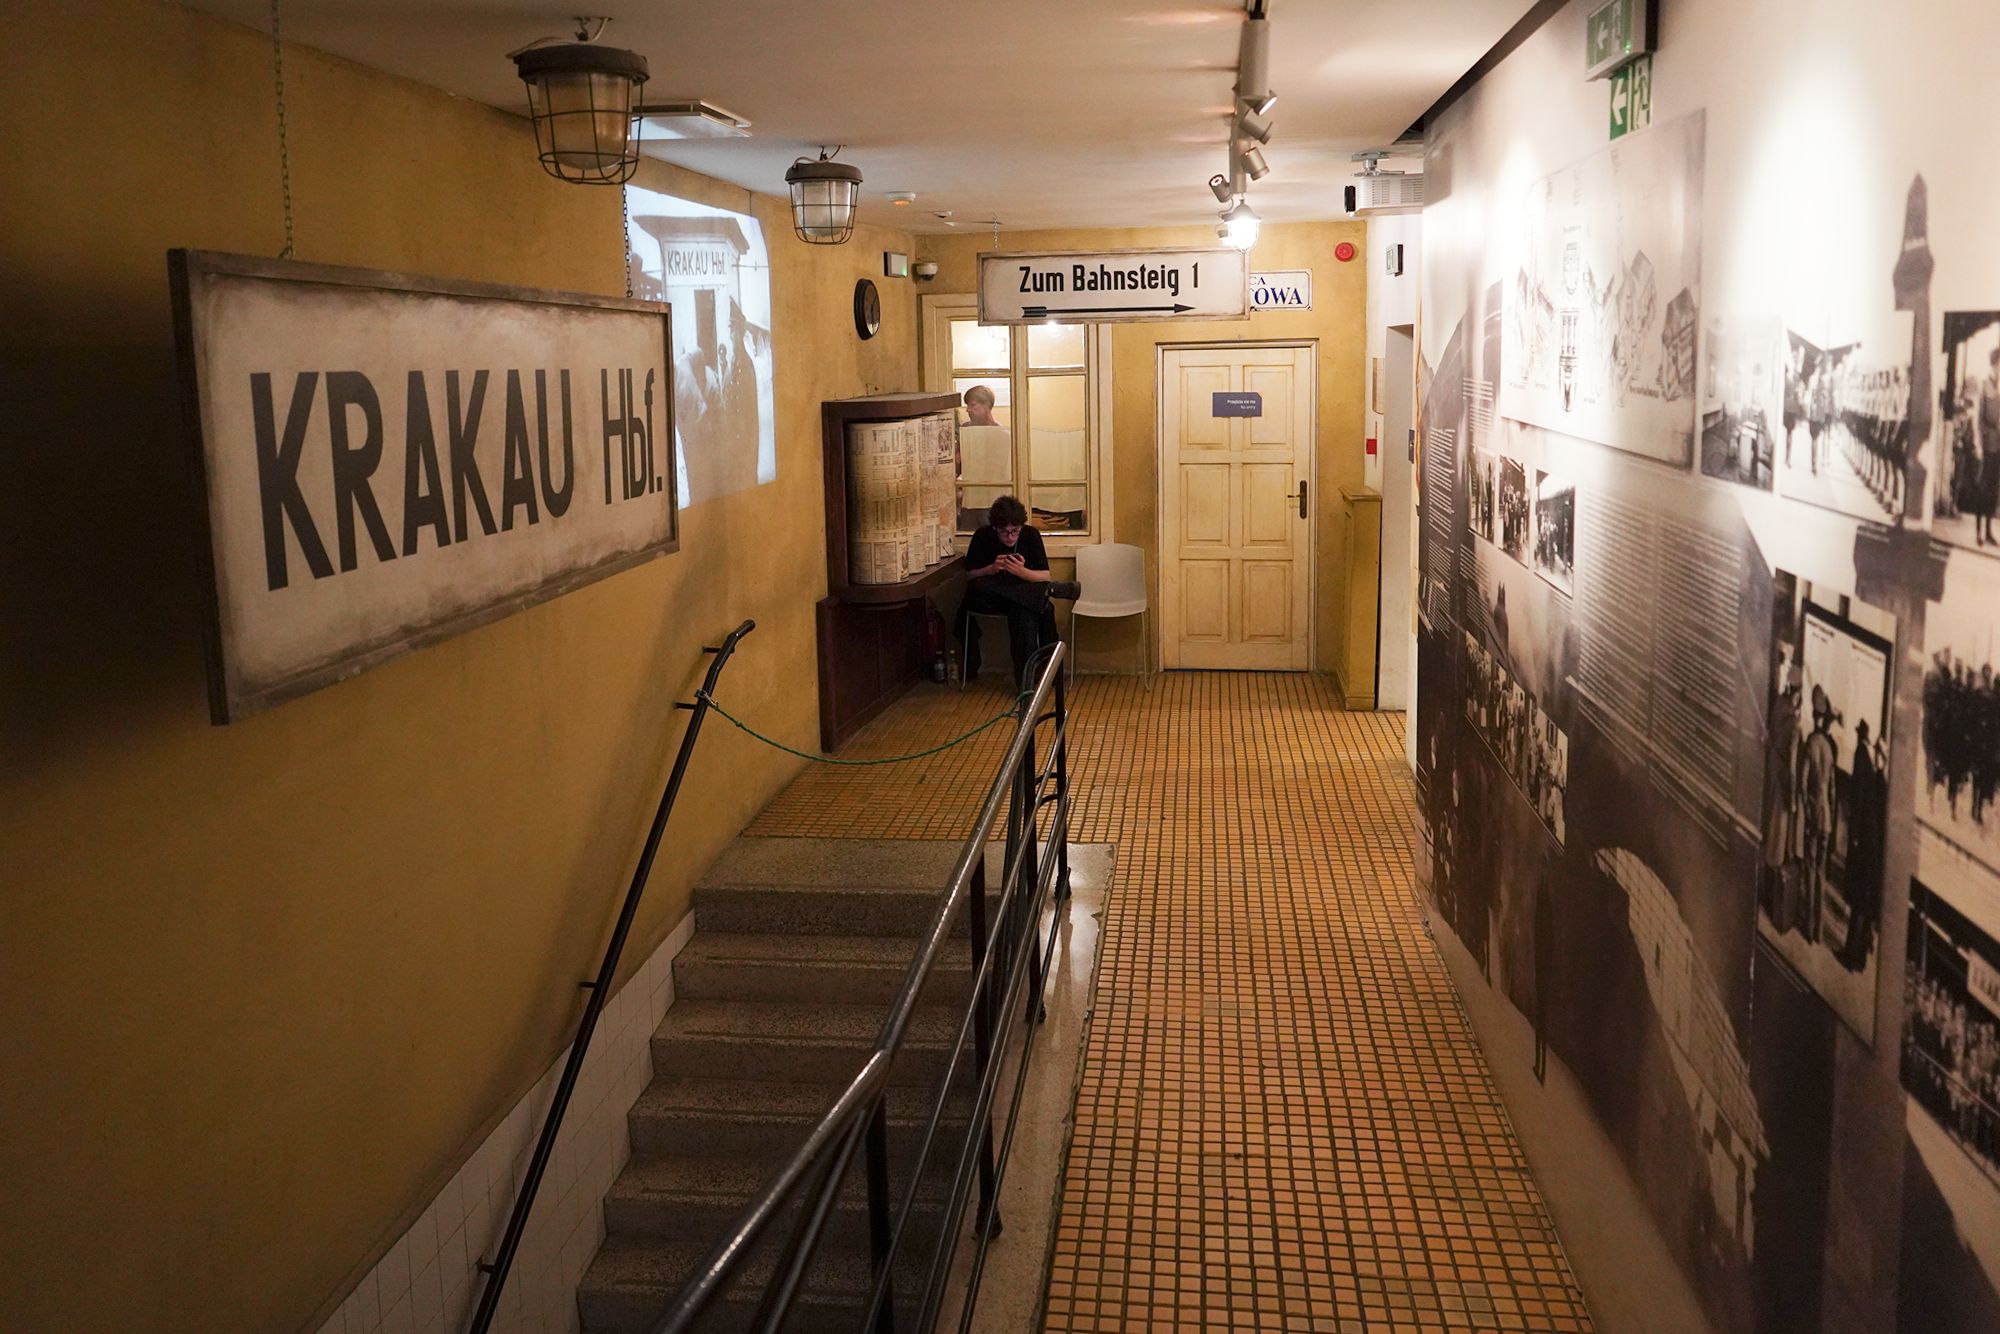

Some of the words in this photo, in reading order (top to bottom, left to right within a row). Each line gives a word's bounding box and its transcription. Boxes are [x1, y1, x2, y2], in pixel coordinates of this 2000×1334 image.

[667, 250, 708, 276] KRAKAU
[1019, 266, 1064, 293] Zum
[1072, 263, 1179, 297] Bahnsteig
[1191, 262, 1199, 289] 1
[1250, 287, 1303, 306] OWA
[250, 368, 575, 593] KRAKAU
[600, 367, 663, 506] Hbf.
